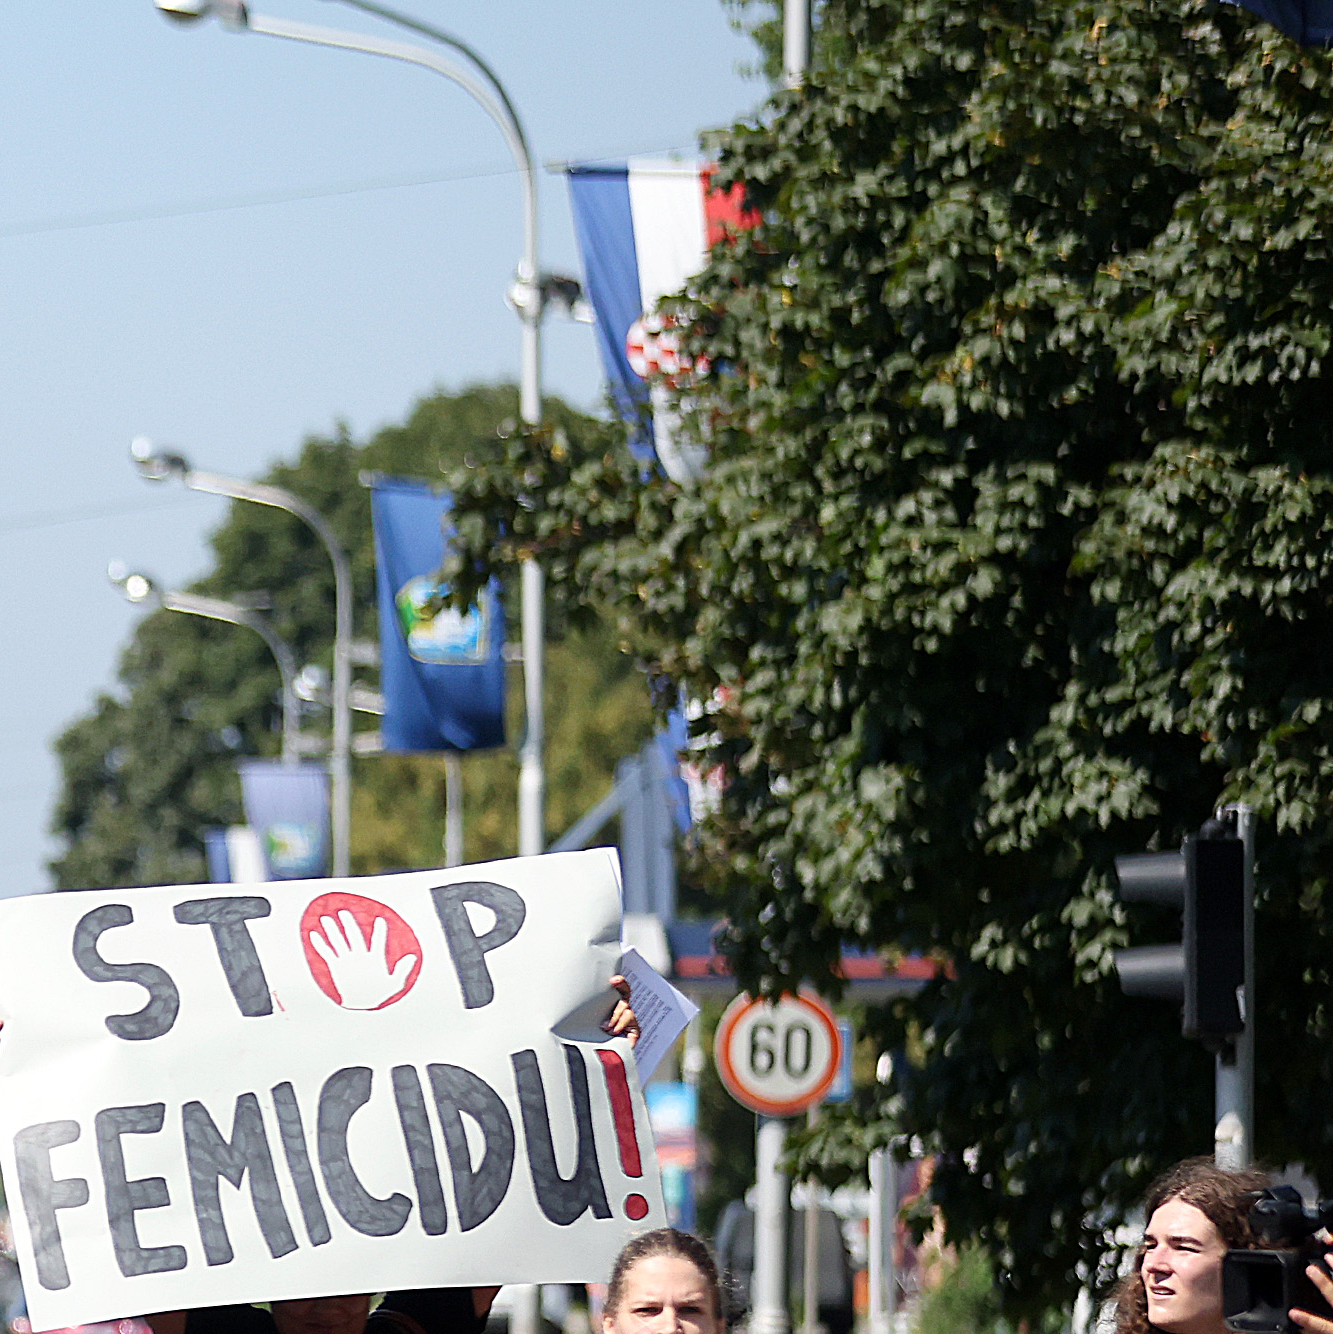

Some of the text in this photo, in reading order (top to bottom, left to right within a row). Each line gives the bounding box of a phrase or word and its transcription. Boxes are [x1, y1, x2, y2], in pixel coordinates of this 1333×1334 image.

[72, 880, 526, 1040] STOP
[750, 1021, 812, 1079] 60
[14, 1043, 650, 1290] FEMICIDU!
